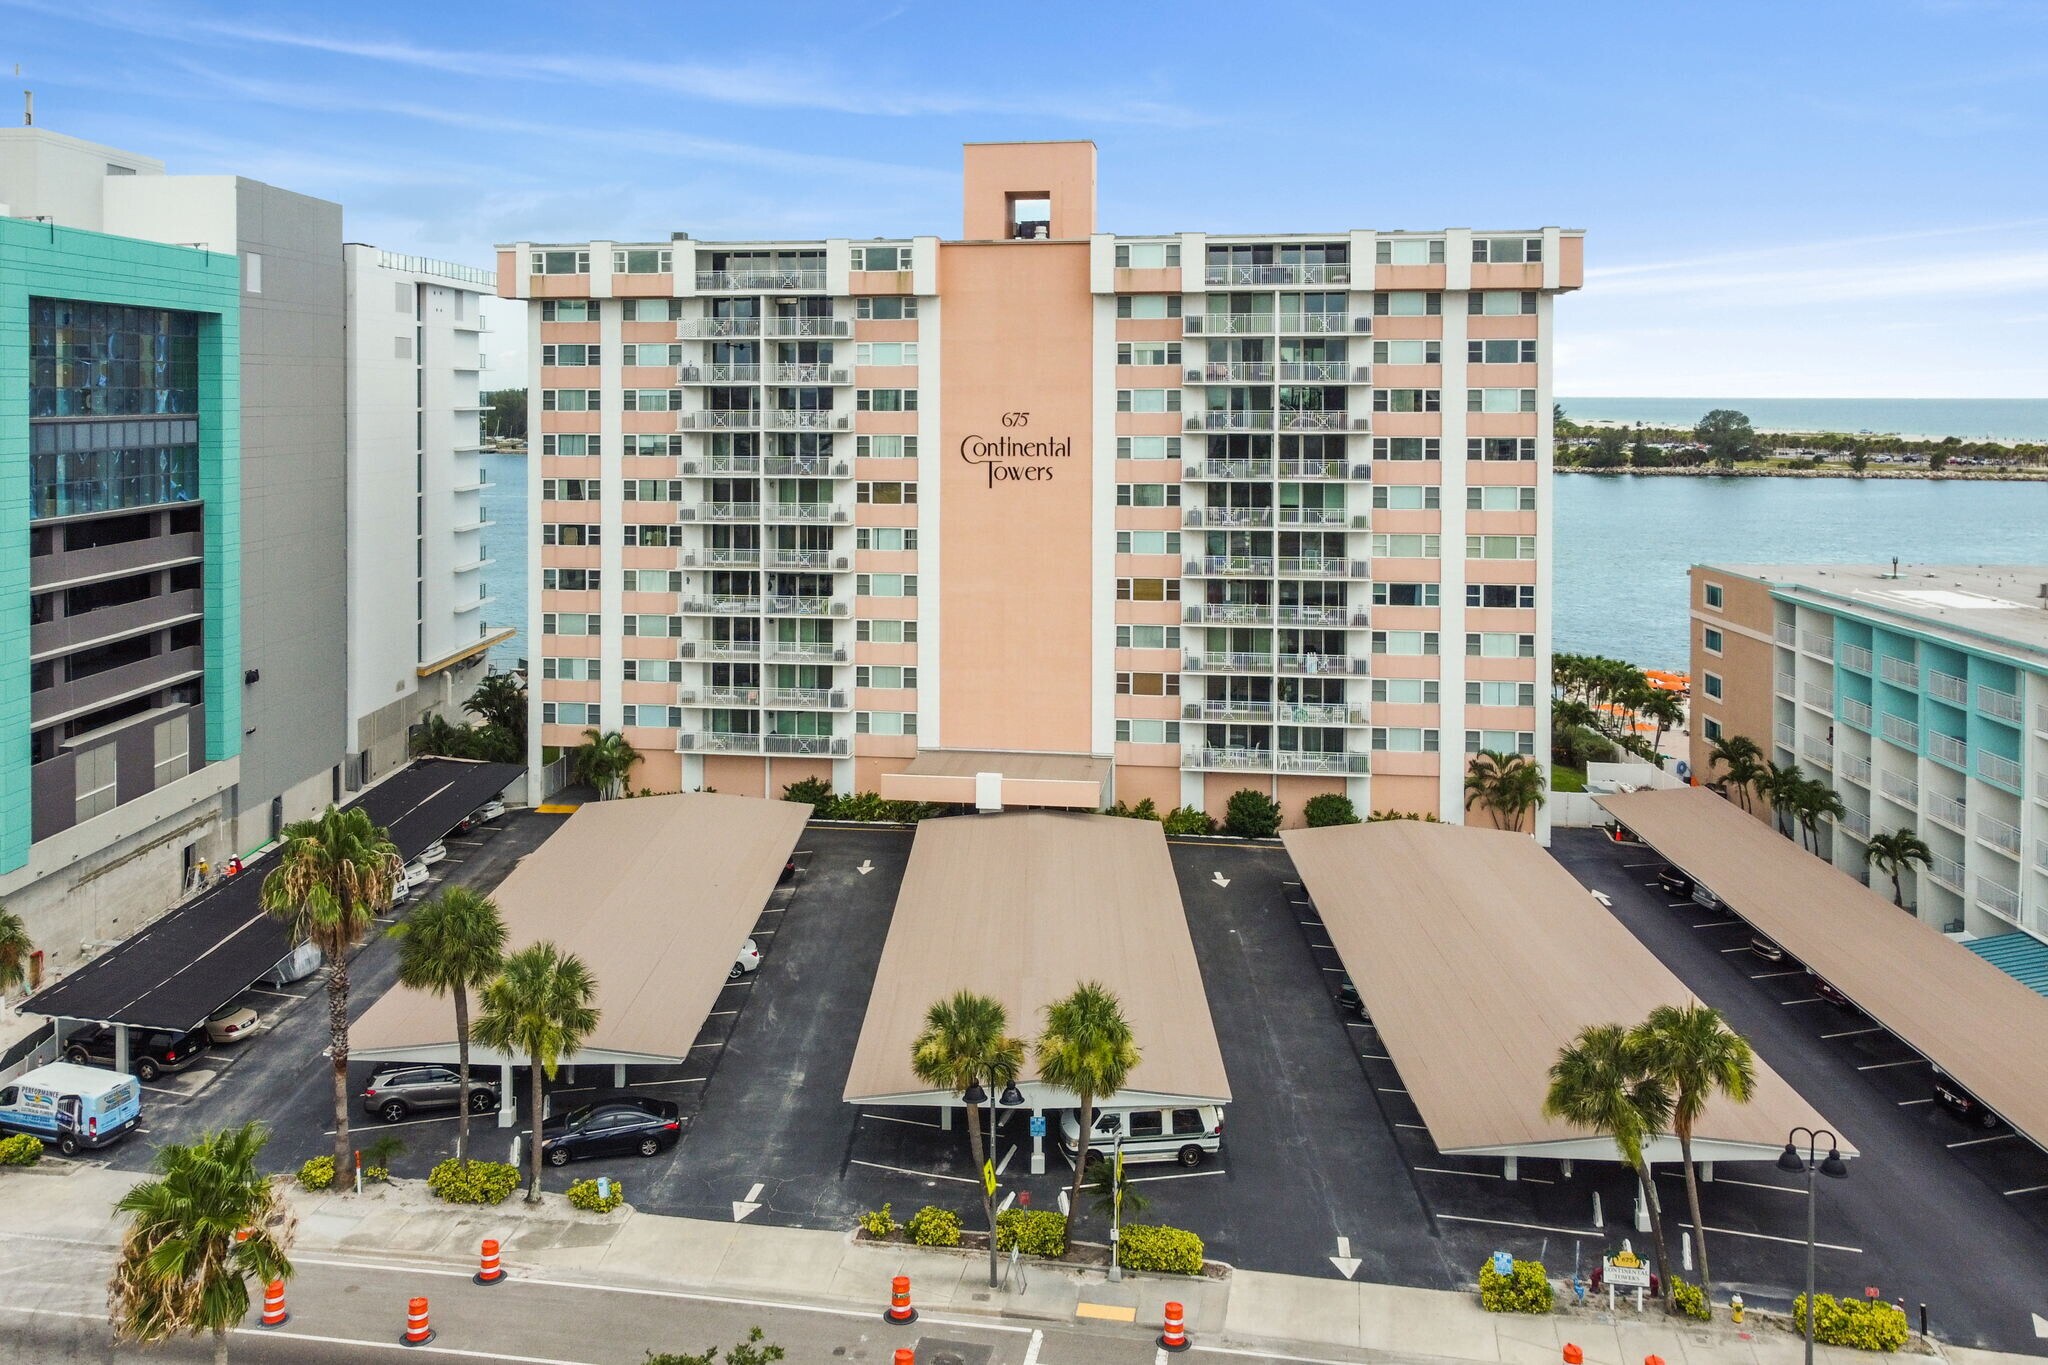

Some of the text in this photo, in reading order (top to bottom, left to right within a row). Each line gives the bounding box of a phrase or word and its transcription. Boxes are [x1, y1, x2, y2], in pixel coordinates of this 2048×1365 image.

[1001, 412, 1030, 427] 675
[960, 434, 1071, 465] Continental
[979, 460, 1053, 489] Towers
[21, 1086, 59, 1098] PERFORMANCE
[1604, 1267, 1648, 1276] CONTINENTAL
